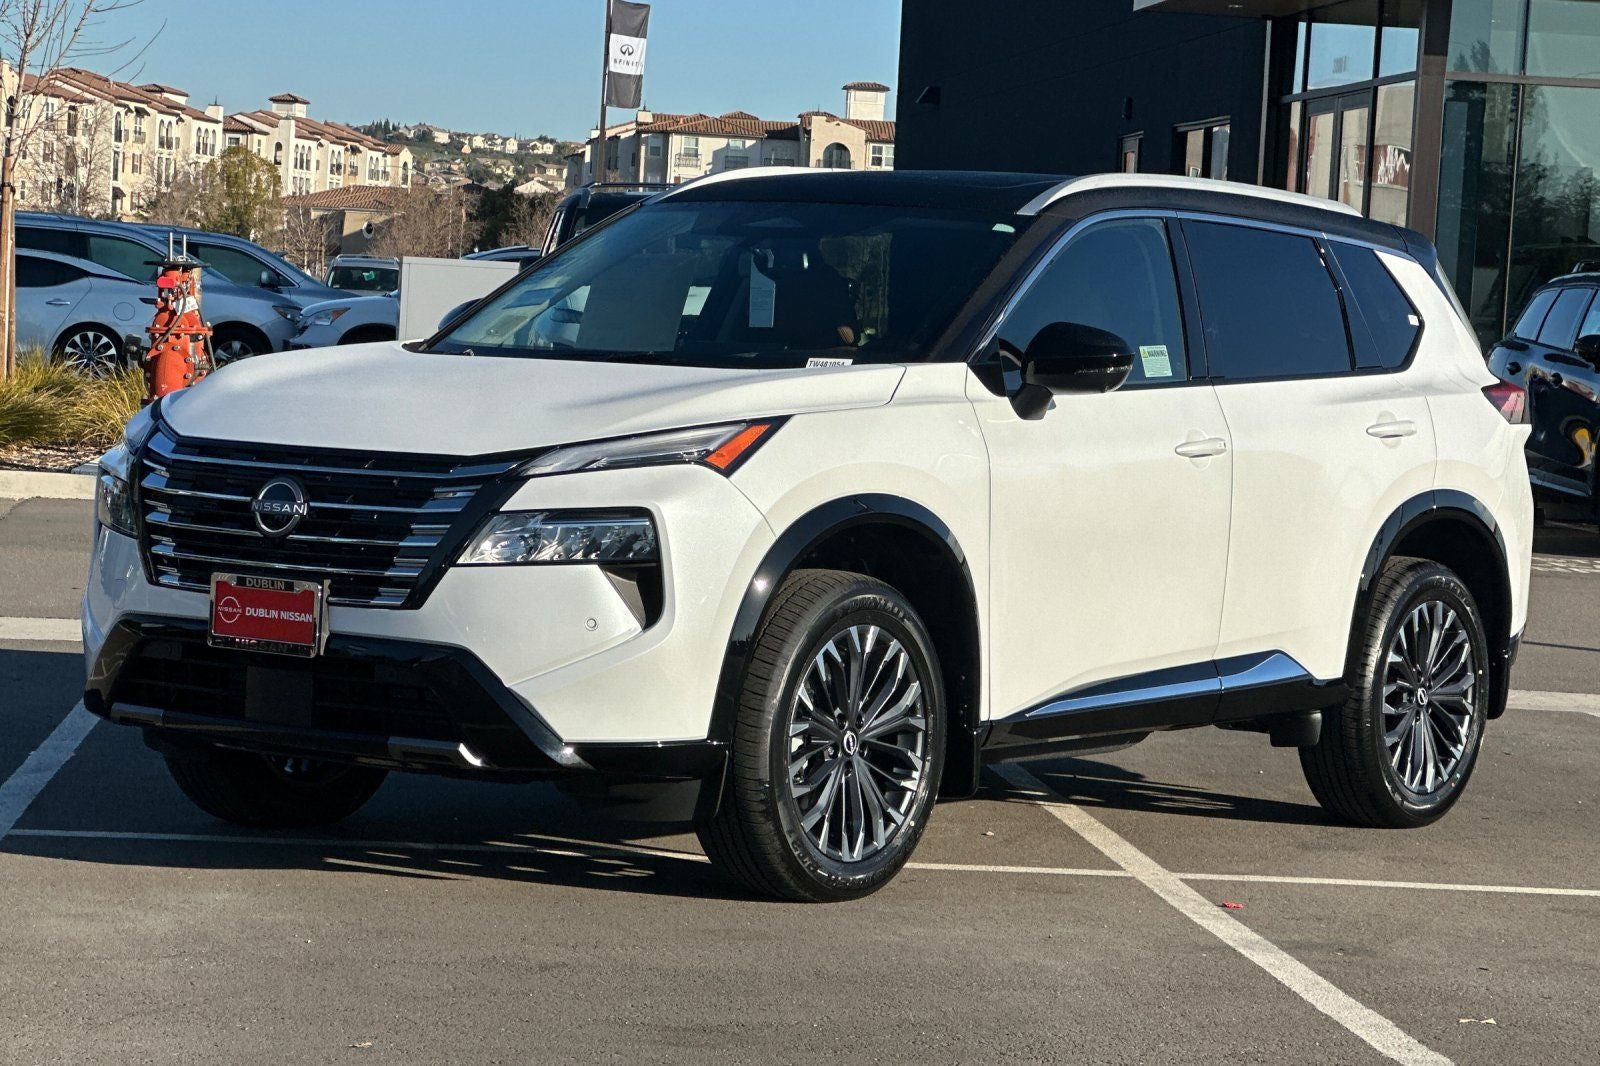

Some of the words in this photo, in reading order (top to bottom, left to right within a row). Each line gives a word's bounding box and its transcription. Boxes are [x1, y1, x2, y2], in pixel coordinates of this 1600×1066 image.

[251, 500, 305, 514] NISSAN
[246, 577, 286, 590] DUBLIN
[217, 606, 243, 614] NISSAN
[245, 606, 279, 620] DUBLIN
[280, 610, 313, 623] NISSAN
